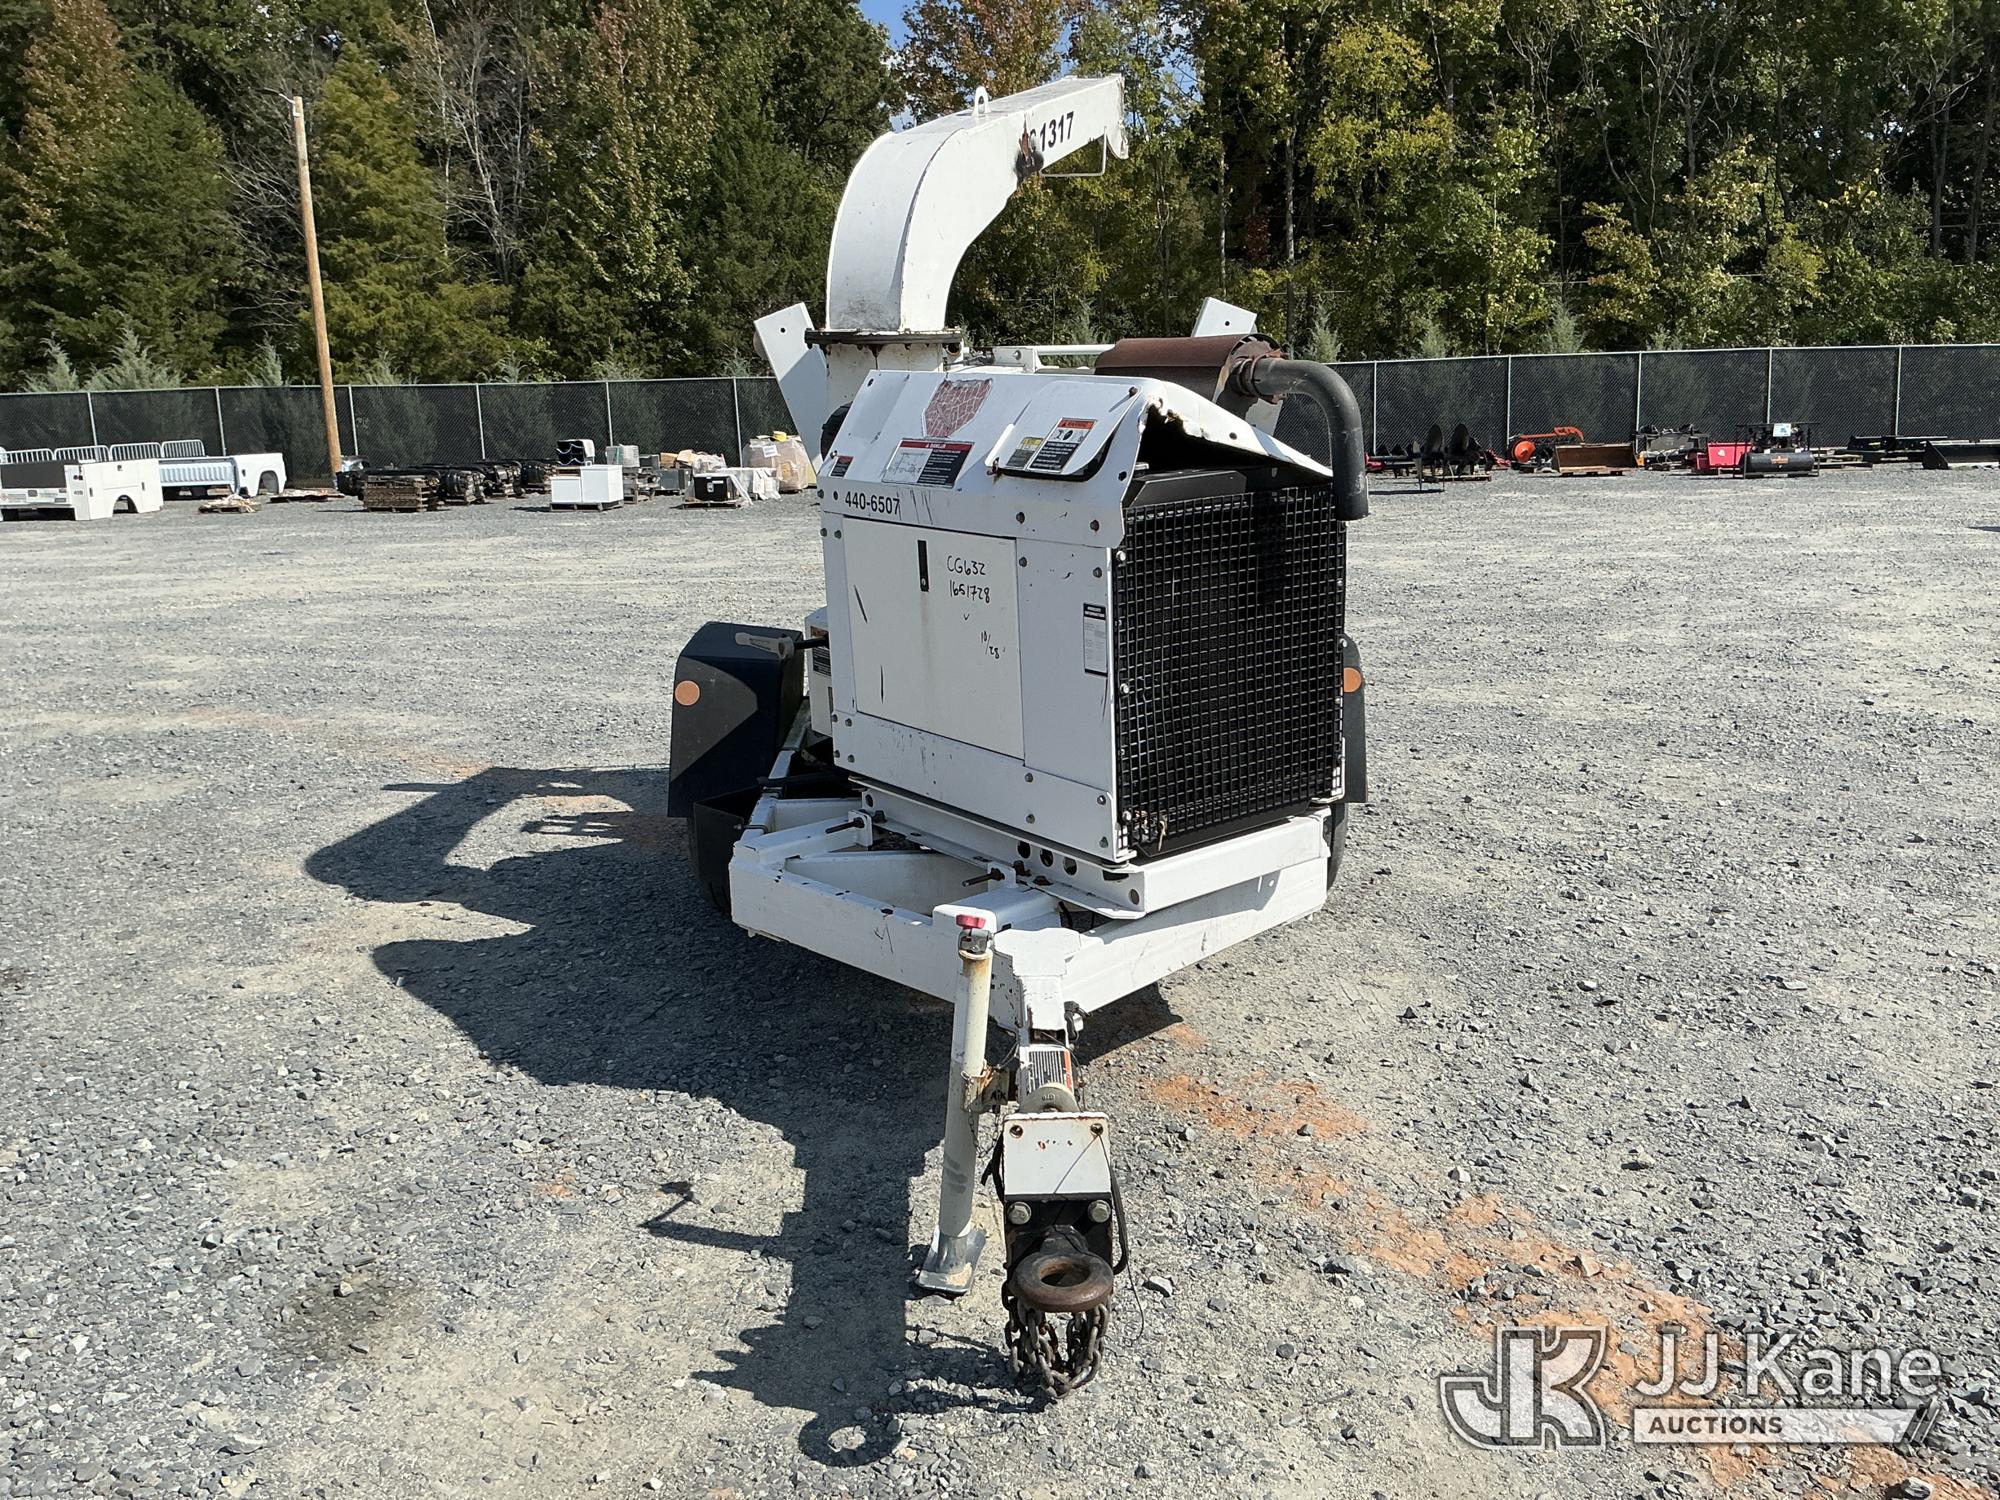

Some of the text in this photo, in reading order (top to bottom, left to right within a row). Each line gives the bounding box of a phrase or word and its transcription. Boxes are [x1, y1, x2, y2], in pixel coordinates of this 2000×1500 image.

[845, 491, 900, 515] 440-6507
[947, 555, 986, 576] CG632
[949, 579, 990, 604] 1651728
